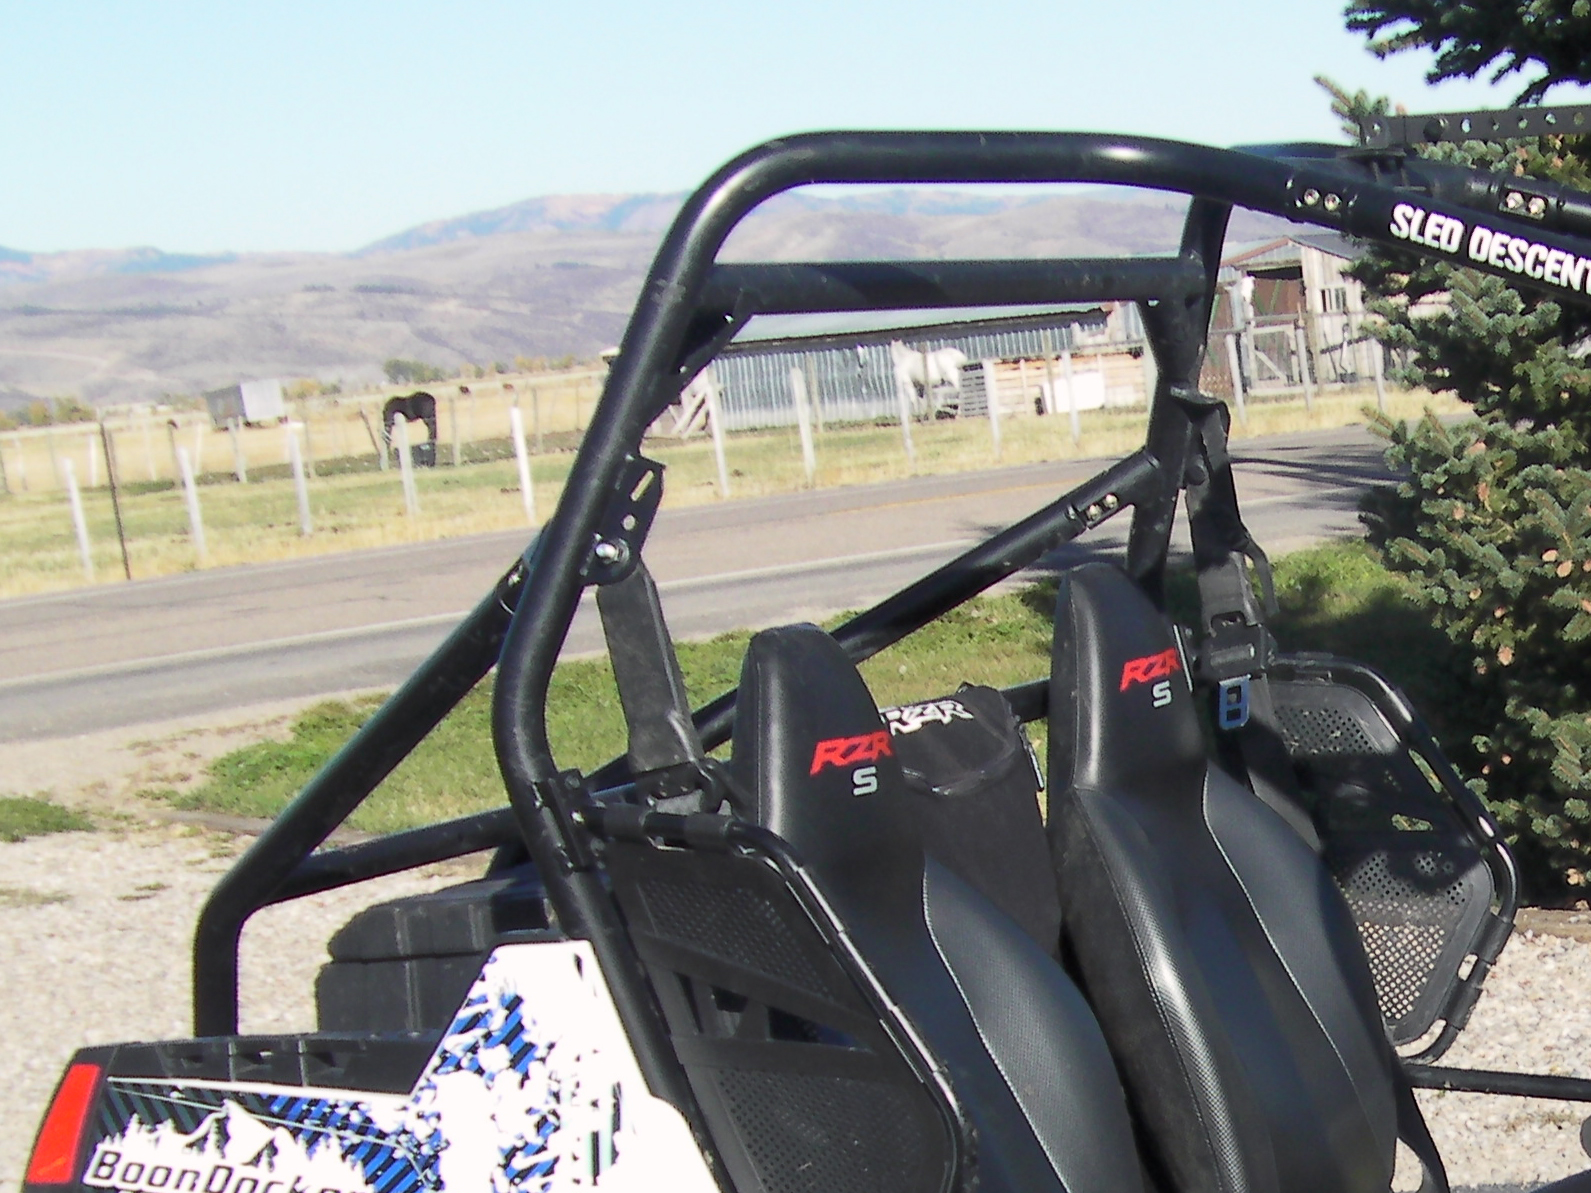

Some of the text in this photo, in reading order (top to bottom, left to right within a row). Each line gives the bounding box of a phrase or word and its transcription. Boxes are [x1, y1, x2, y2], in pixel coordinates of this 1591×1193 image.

[1389, 203, 1466, 254] SLED
[1119, 646, 1181, 693] RZR
[1152, 680, 1172, 708] S
[809, 730, 892, 777] RZR
[852, 765, 878, 797] S
